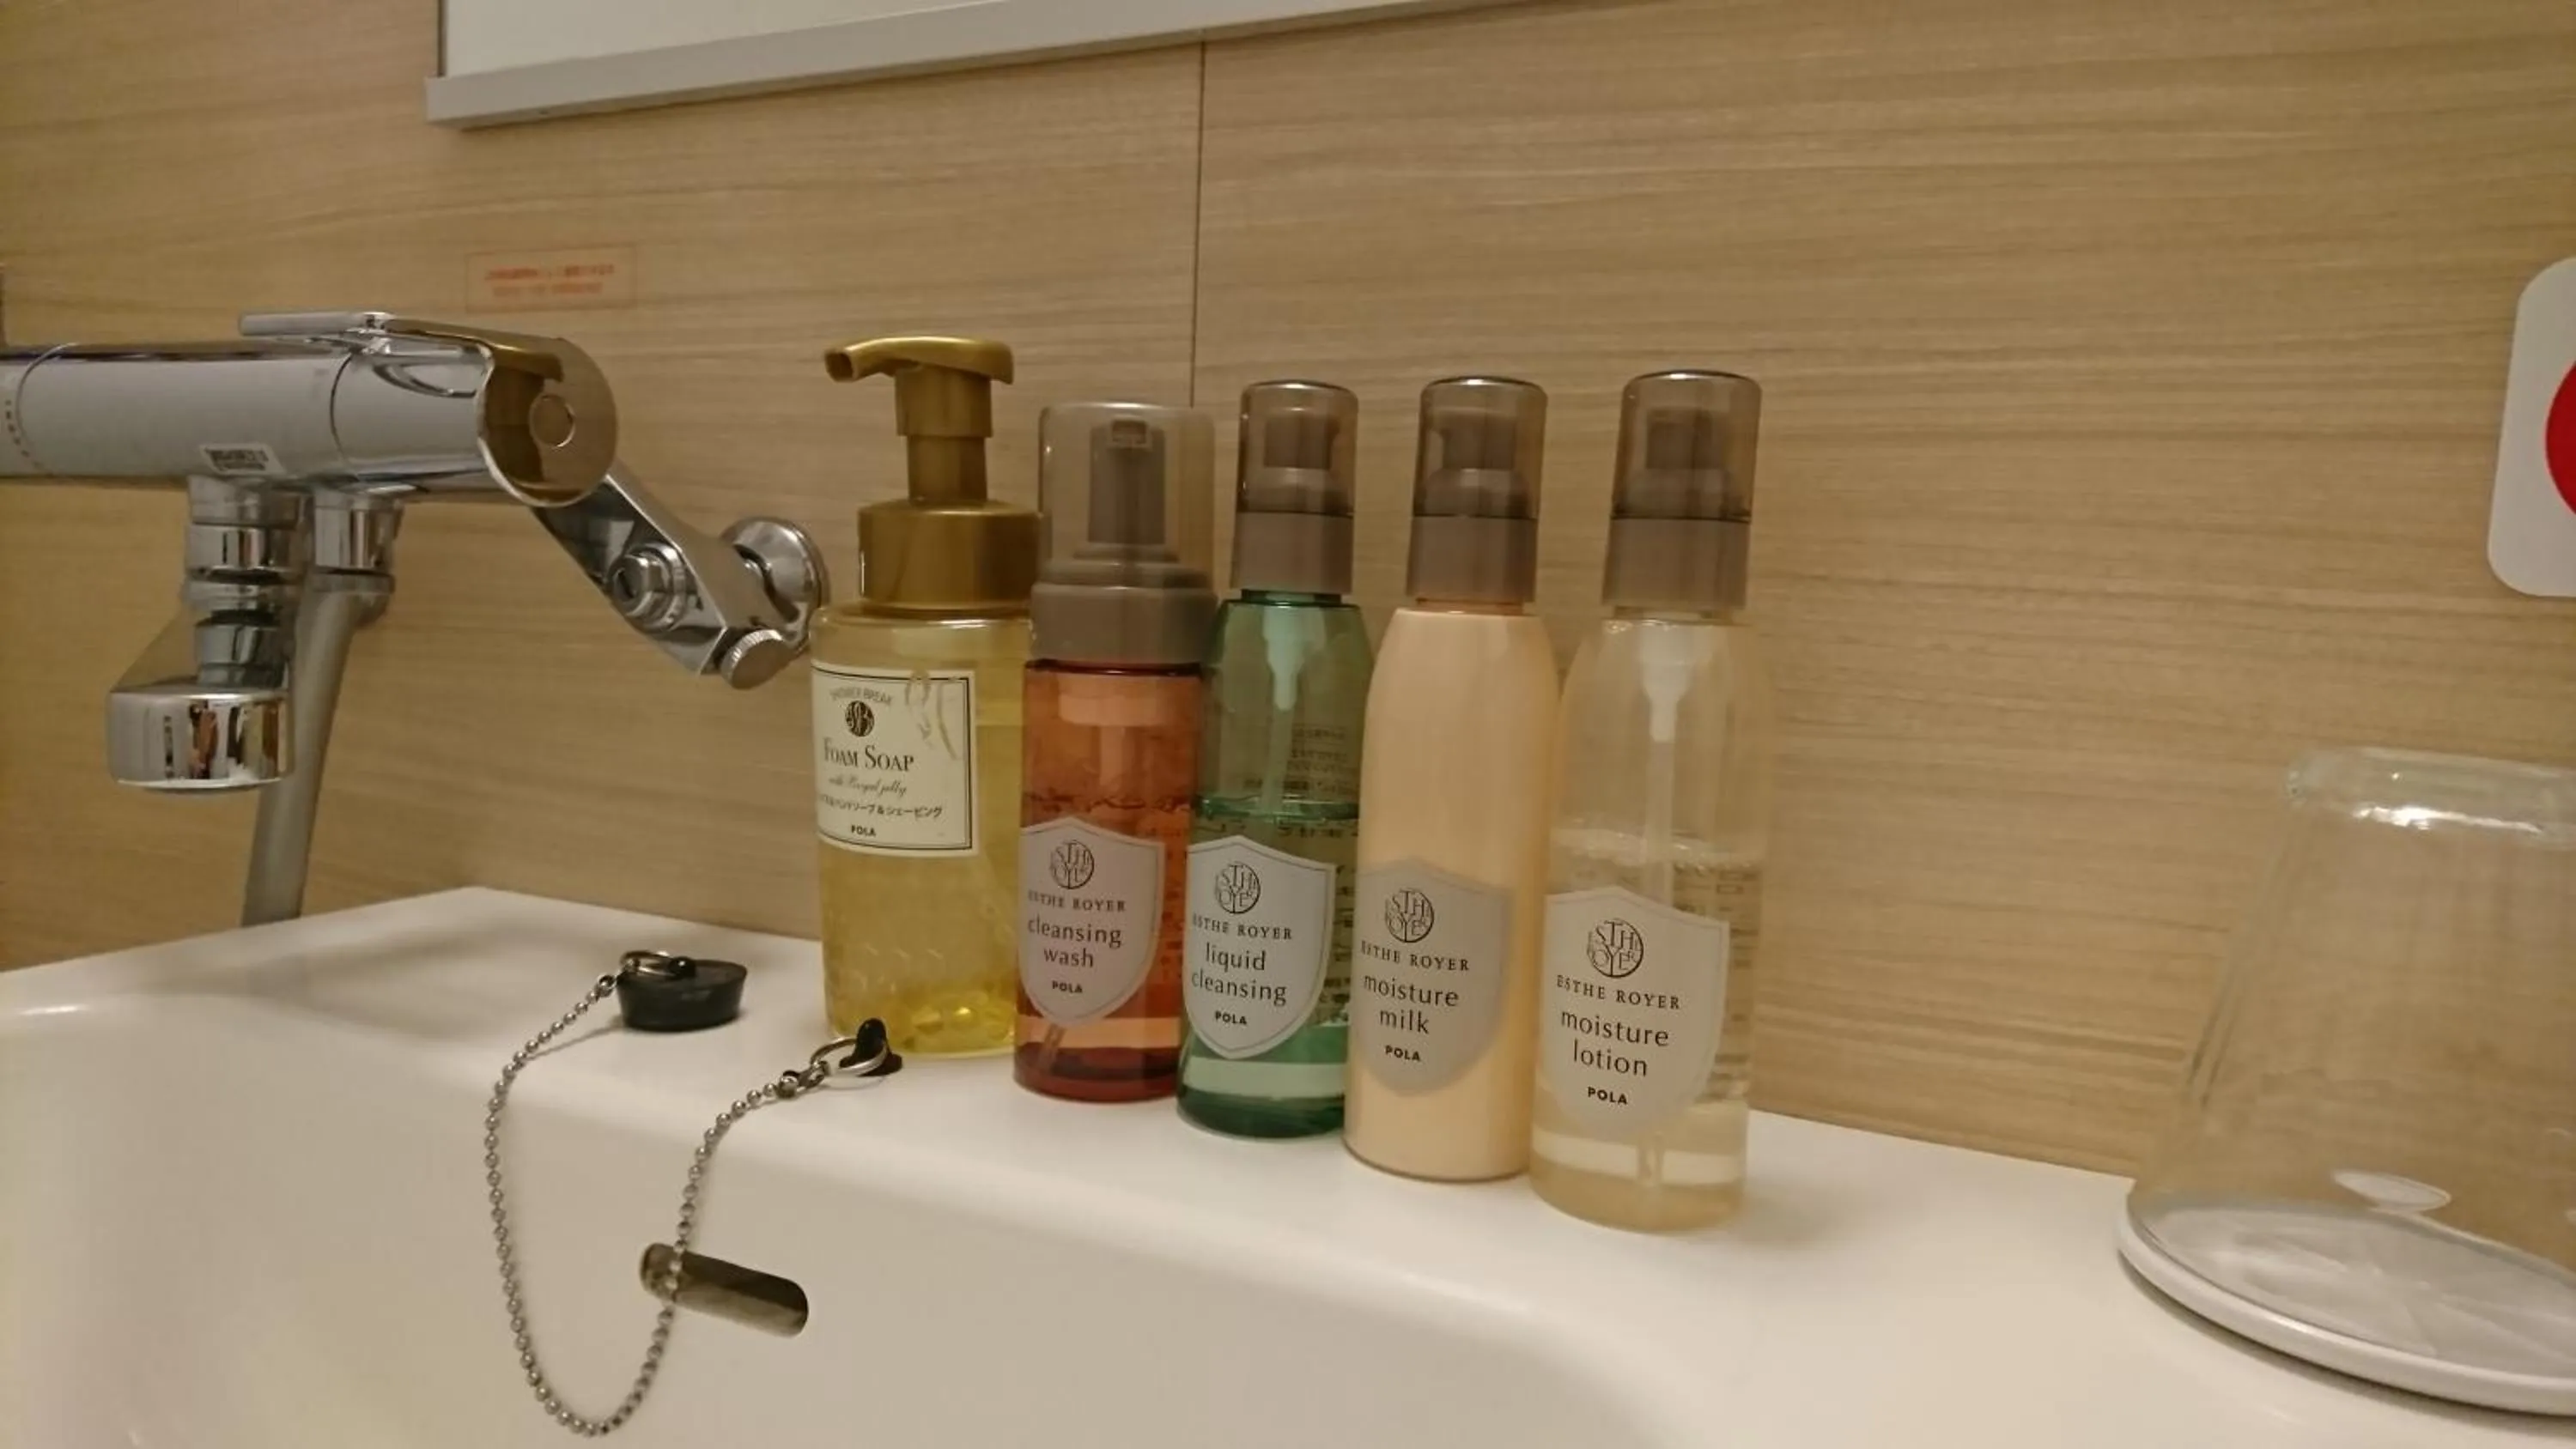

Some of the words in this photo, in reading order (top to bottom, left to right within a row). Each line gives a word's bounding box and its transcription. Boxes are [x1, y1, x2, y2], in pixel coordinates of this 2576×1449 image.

[865, 745, 914, 772] SOAP
[851, 824, 877, 837] POLA
[1072, 897, 1127, 912] ROYER
[1028, 913, 1123, 949] cleansing
[1237, 925, 1292, 940] ROYER
[1043, 948, 1094, 968] wash
[1206, 942, 1267, 972] liquid
[1410, 954, 1469, 971] ROYER
[1052, 979, 1083, 994] POLA
[1192, 968, 1287, 1007] cleansing
[1364, 975, 1459, 1007] moisture
[1557, 975, 1606, 999] ESTHE
[1616, 990, 1680, 1009] ROYER
[1215, 1010, 1247, 1025] POLA
[1380, 1009, 1430, 1034] milk
[1561, 1010, 1669, 1046] moisture
[1385, 1045, 1421, 1062] POLA
[1573, 1039, 1648, 1077] lotion
[1588, 1086, 1628, 1105] POLA
